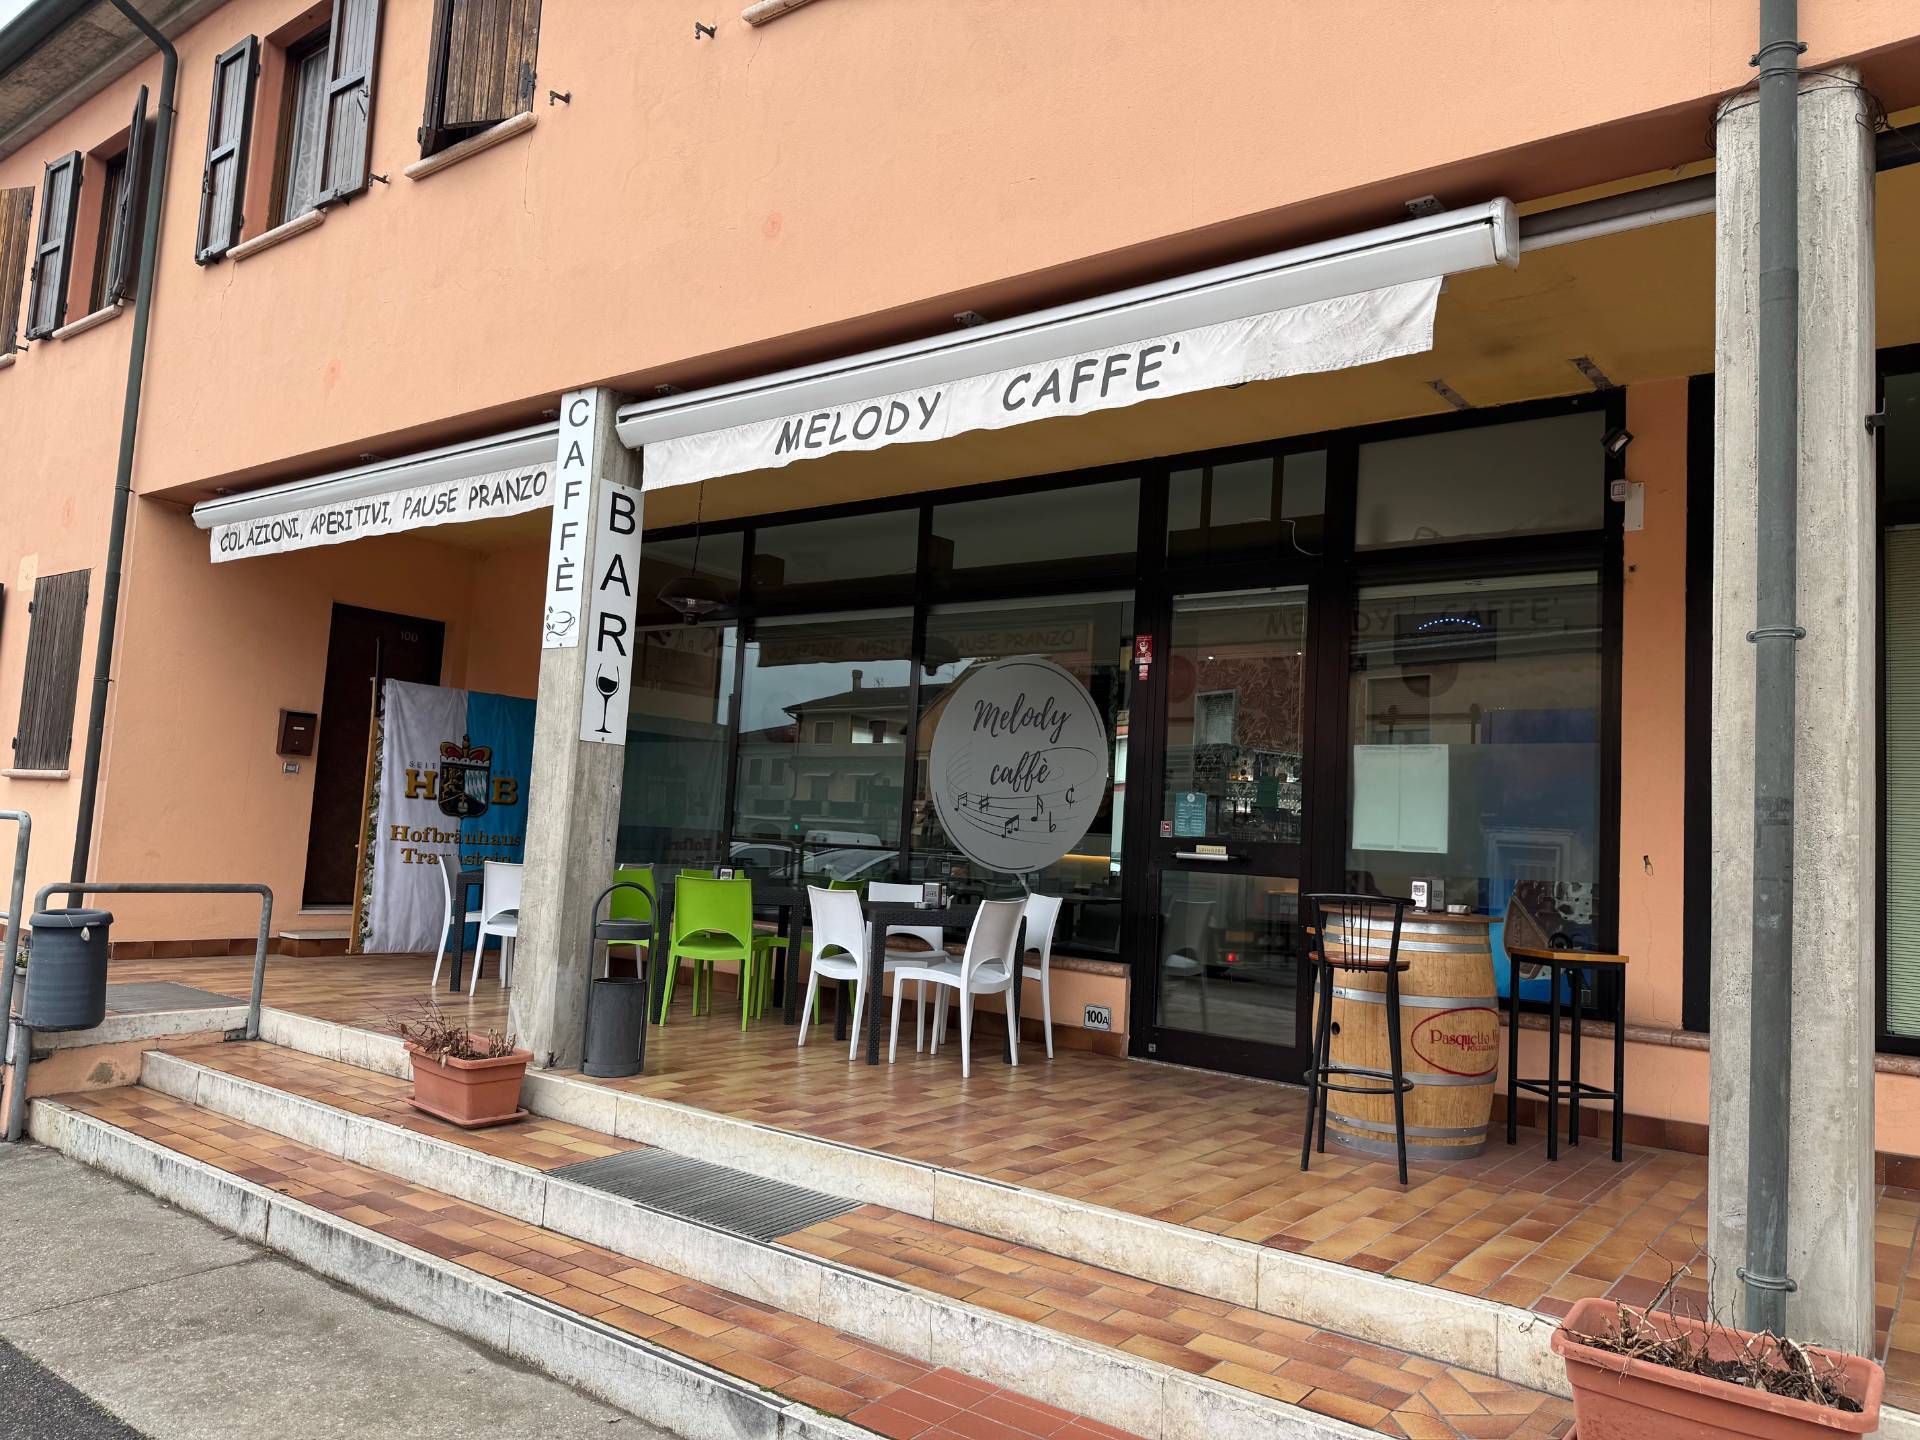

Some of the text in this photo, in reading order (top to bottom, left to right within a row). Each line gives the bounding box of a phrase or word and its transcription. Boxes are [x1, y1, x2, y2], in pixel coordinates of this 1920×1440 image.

[774, 341, 1181, 456] MELODY CAFFE'
[220, 470, 548, 553] COLAZIONI, APERITIVI, PAUSE PRANZO
[555, 398, 590, 593] CAFFÈ
[598, 491, 637, 657] BAR
[972, 692, 1072, 744] Melody
[405, 769, 520, 805] H B
[989, 750, 1051, 793] caffè
[1086, 1009, 1109, 1025] 100A
